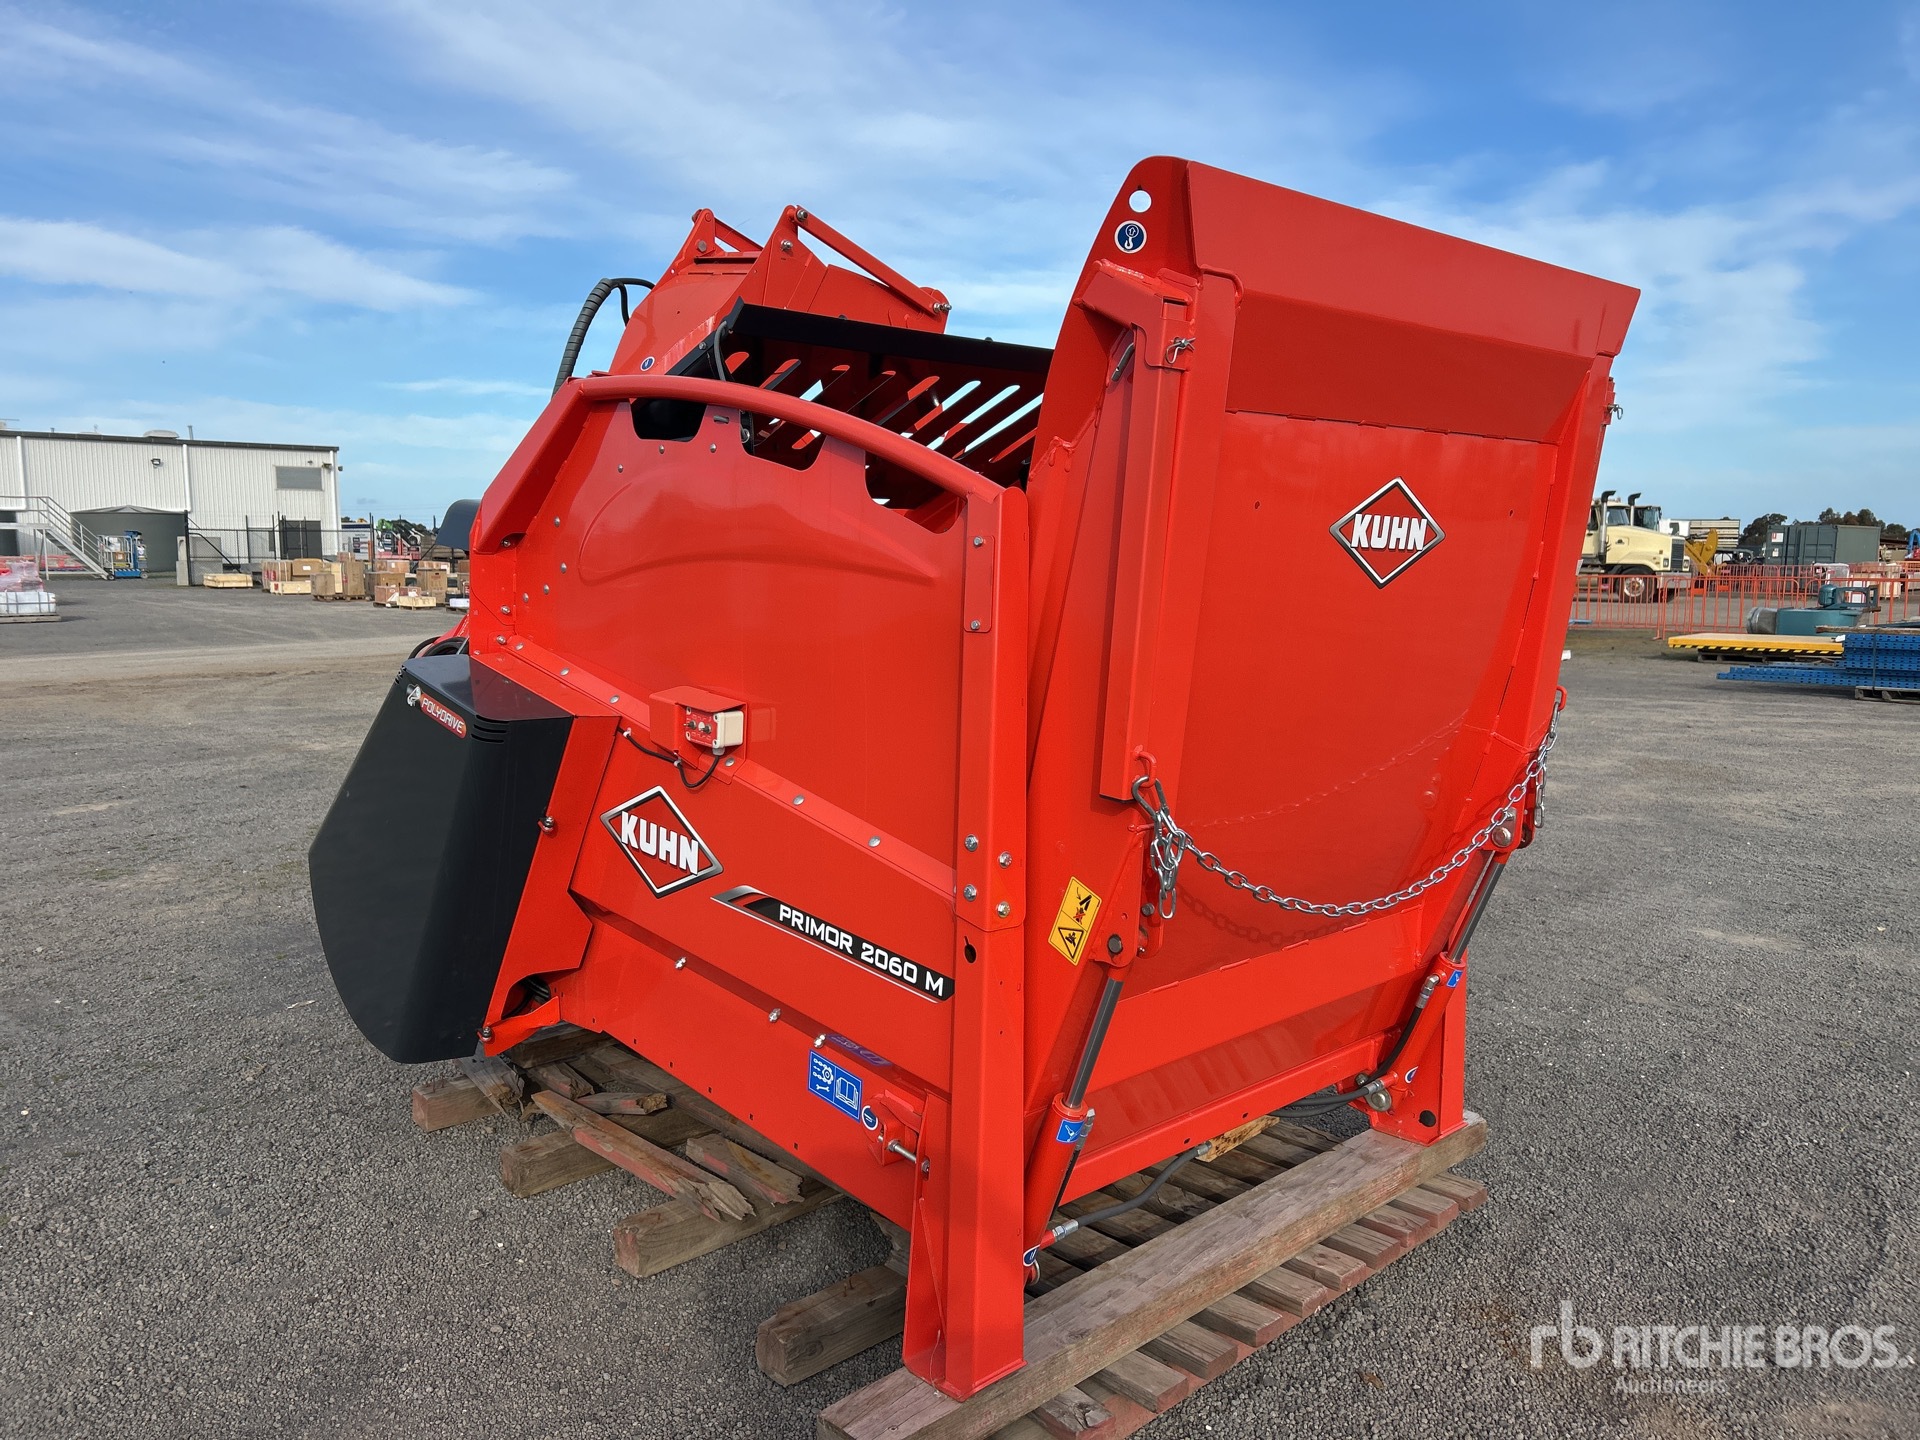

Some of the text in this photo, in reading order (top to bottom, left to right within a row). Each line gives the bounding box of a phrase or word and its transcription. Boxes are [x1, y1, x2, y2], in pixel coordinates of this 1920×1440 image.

[1351, 513, 1428, 551] KUHN
[421, 697, 465, 734] POLYDRIVE
[621, 811, 699, 875] KUHN
[779, 903, 944, 997] PRIMOR 2060 M
